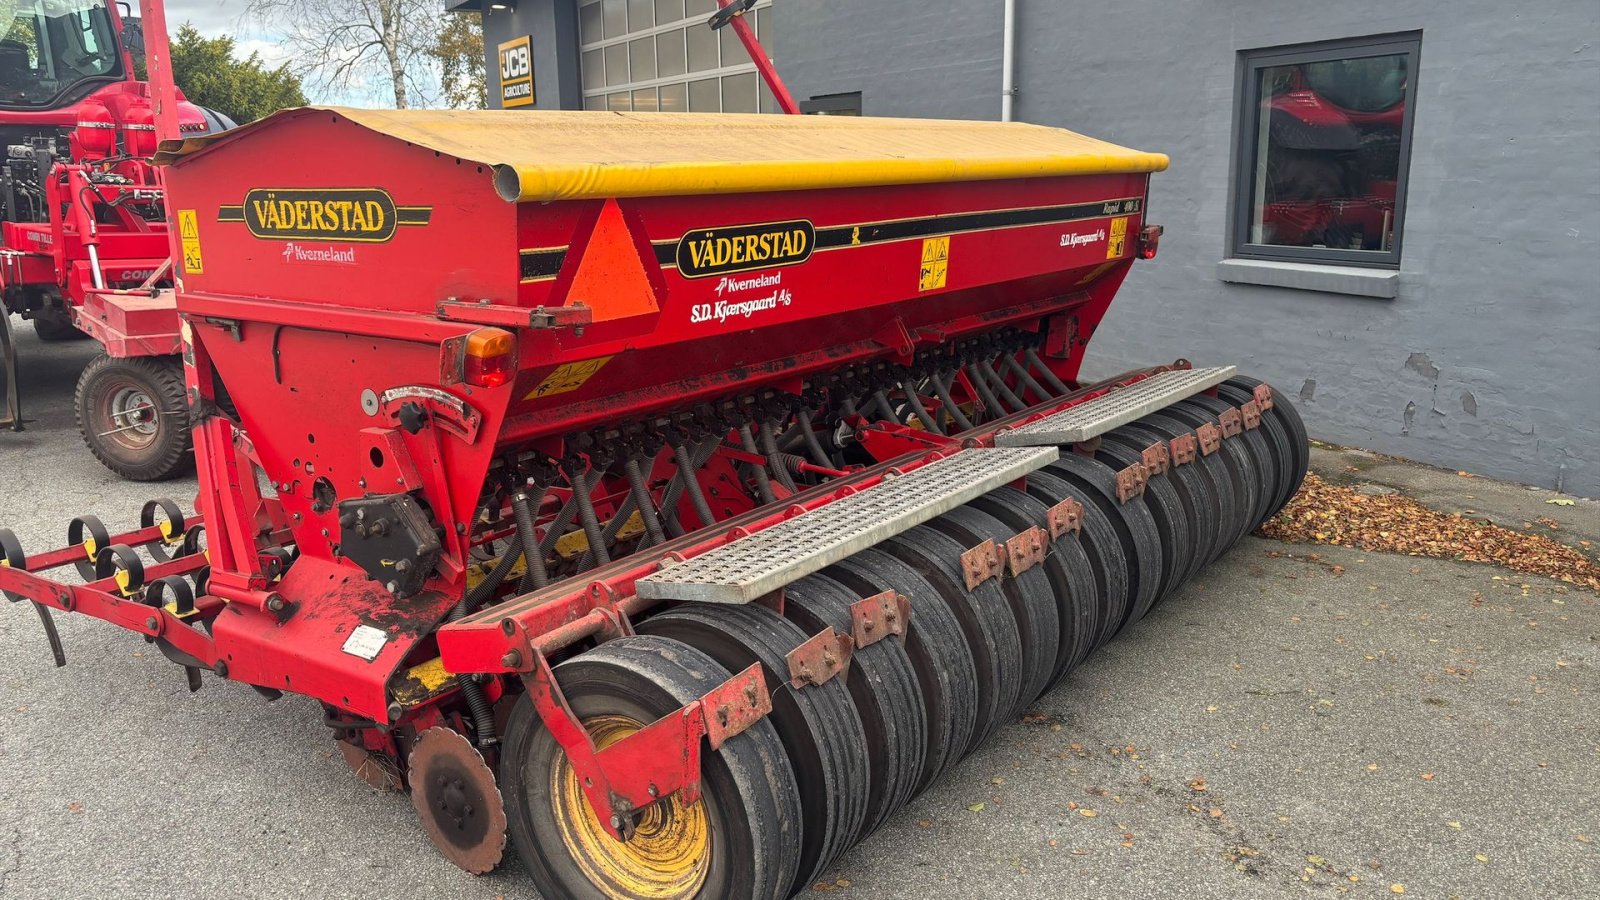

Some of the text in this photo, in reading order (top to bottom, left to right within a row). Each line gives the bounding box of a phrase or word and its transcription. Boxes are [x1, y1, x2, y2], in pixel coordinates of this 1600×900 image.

[502, 46, 529, 79] JCB
[504, 82, 531, 98] AGRICULTURE
[252, 193, 385, 233] VÄDERSTAD
[41, 233, 53, 245] TILLE
[688, 229, 807, 269] VÄDERSTAD
[295, 245, 355, 262] Kverneland
[728, 272, 781, 292] Kverneland
[713, 291, 776, 323] Kjærsgaard
